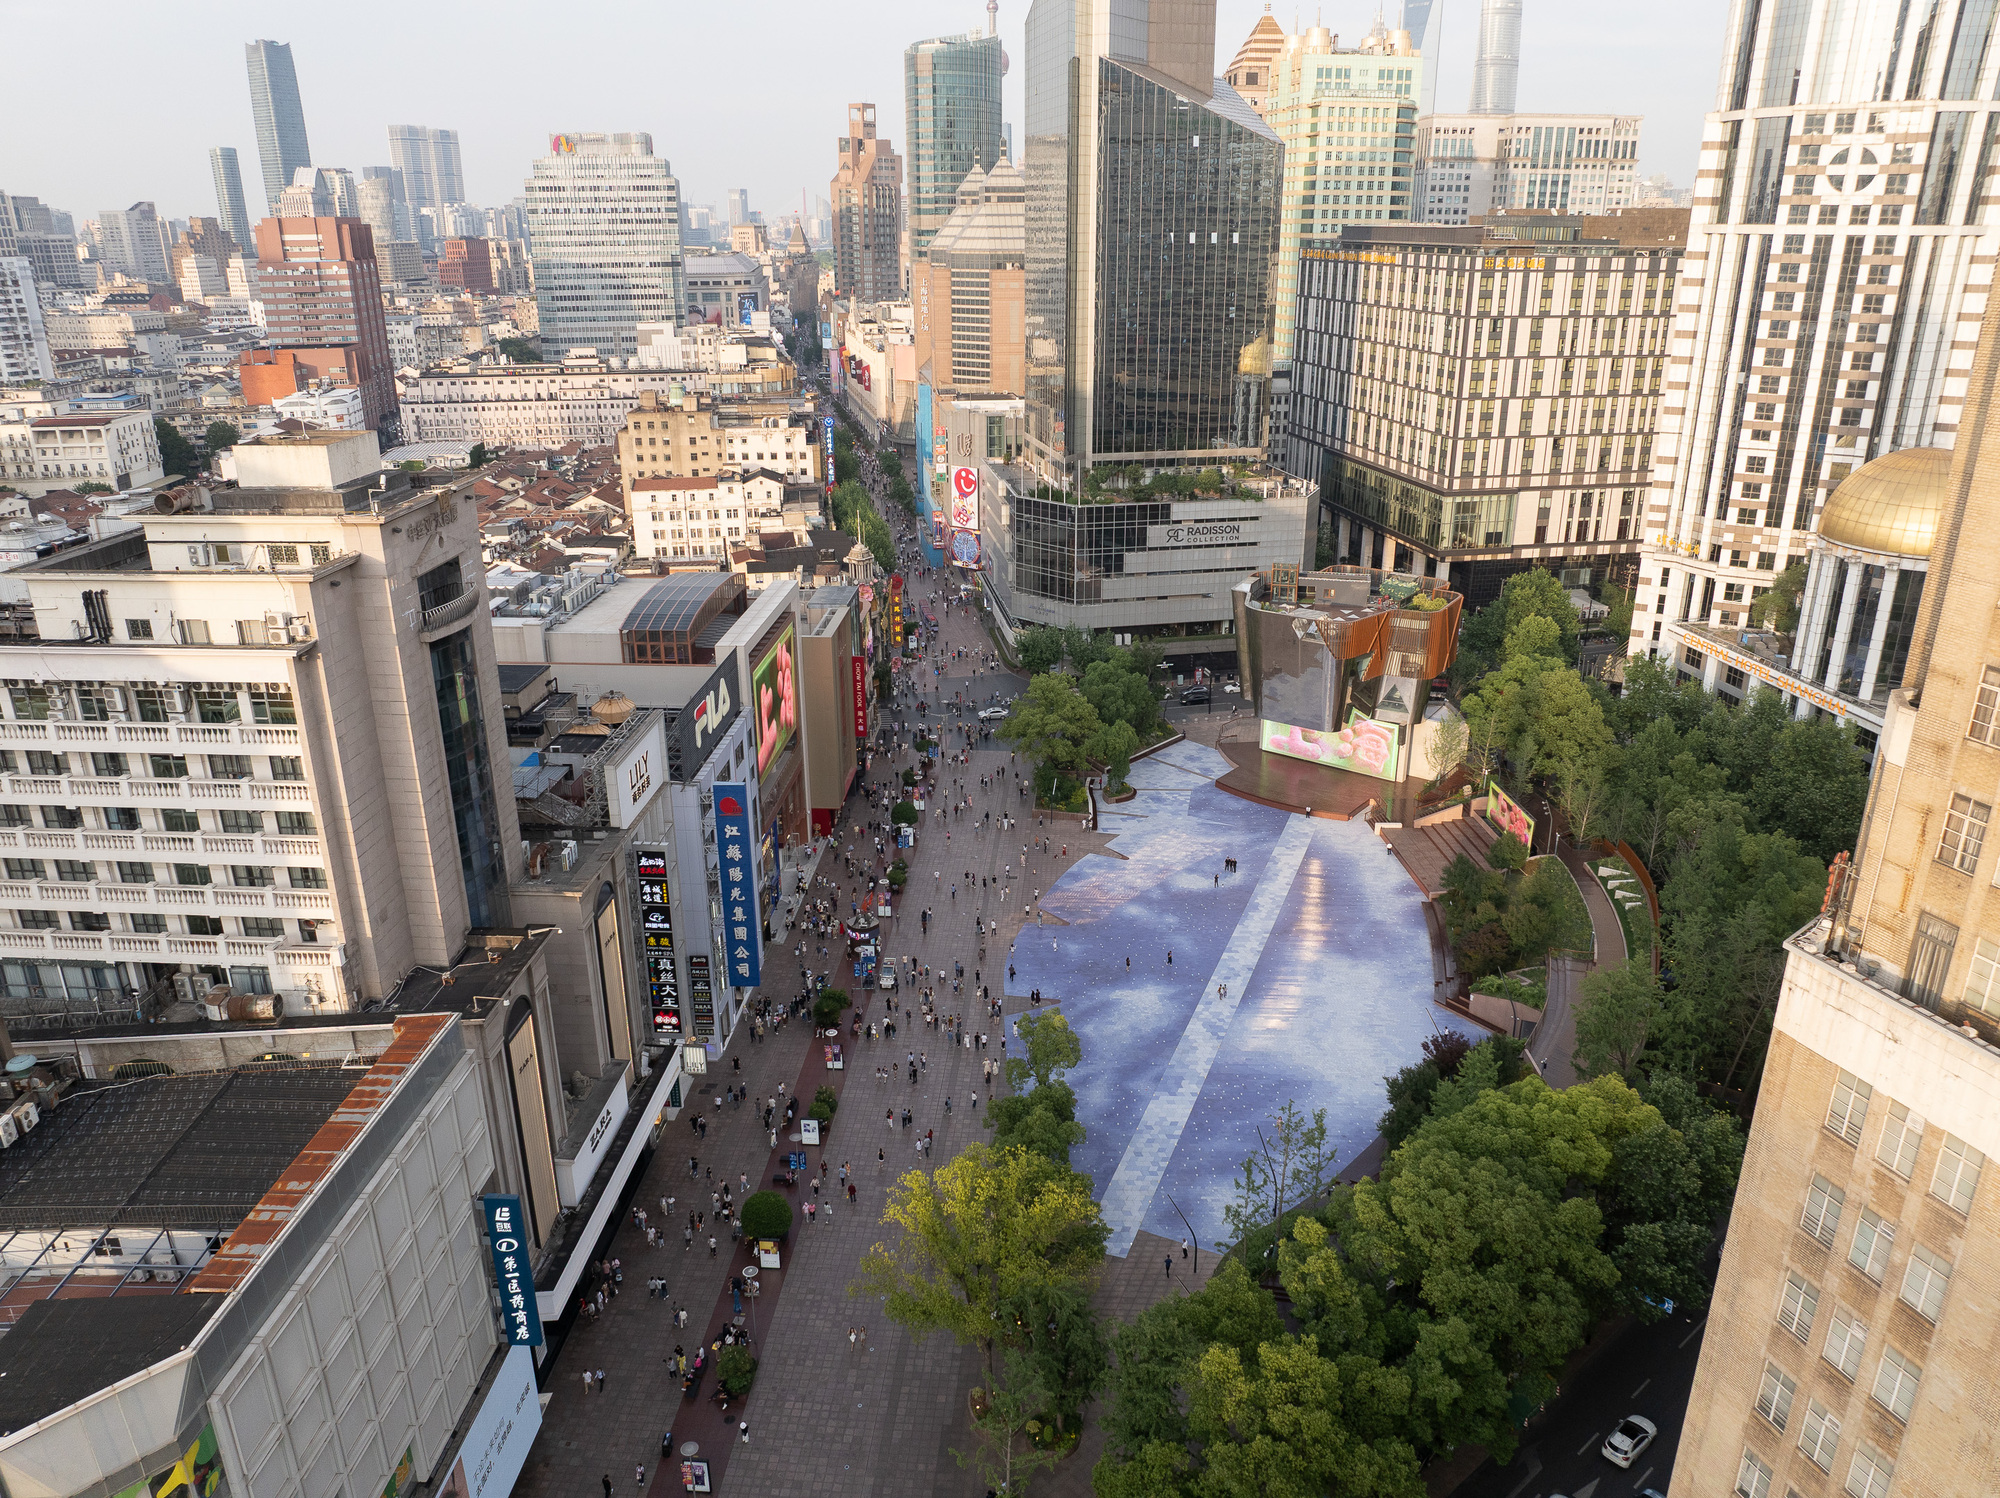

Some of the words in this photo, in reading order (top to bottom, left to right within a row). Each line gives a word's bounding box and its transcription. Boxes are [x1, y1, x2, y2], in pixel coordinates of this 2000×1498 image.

[920, 277, 929, 332] 上海置地广场
[1187, 525, 1240, 536] RADISSON
[1683, 633, 1732, 663] CENTRAL
[1735, 656, 1774, 682] HOTEL
[1777, 675, 1847, 716] SHANGHAI
[694, 677, 731, 749] FILA
[628, 750, 649, 790] LILY
[724, 824, 750, 978] 江蘇陽光集團公司
[657, 958, 679, 1008] 真丝大王
[686, 1061, 704, 1069] LILY
[590, 1108, 612, 1148] ZARA
[503, 1256, 530, 1341] 第一医药商店
